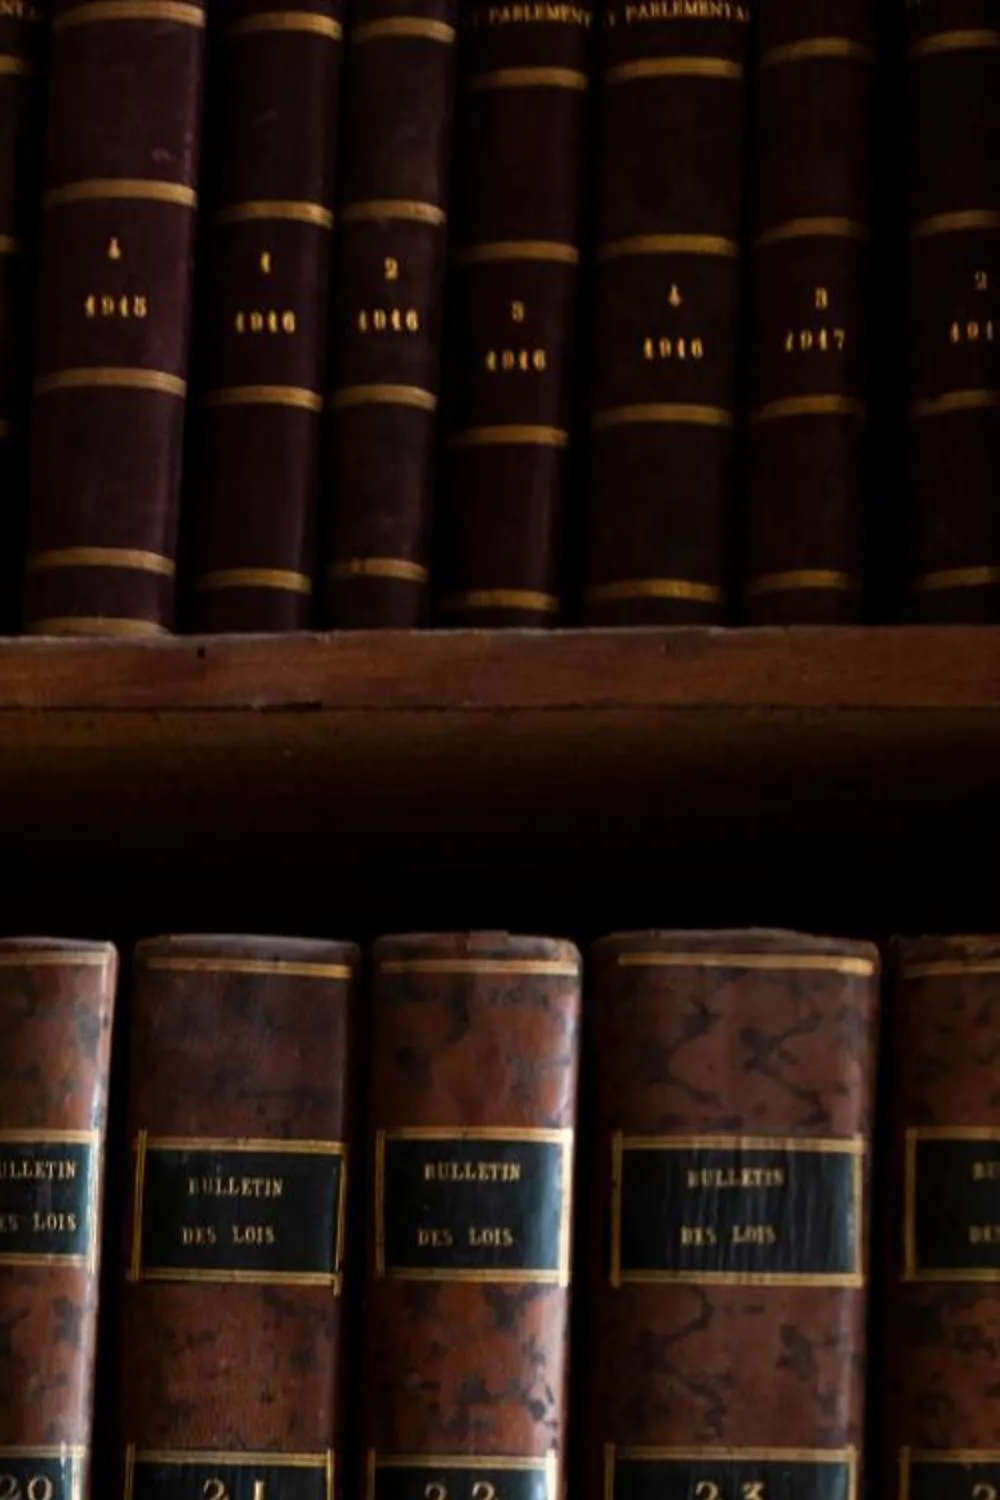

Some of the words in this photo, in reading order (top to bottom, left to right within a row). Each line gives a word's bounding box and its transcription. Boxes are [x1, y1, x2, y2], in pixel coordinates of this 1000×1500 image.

[425, 1160, 522, 1181] BULLETIN
[188, 1177, 283, 1197] BULLETIN
[182, 1226, 217, 1245] DES
[232, 1225, 275, 1244] LOIS
[417, 1228, 453, 1246] DES
[469, 1227, 513, 1246] LOIS
